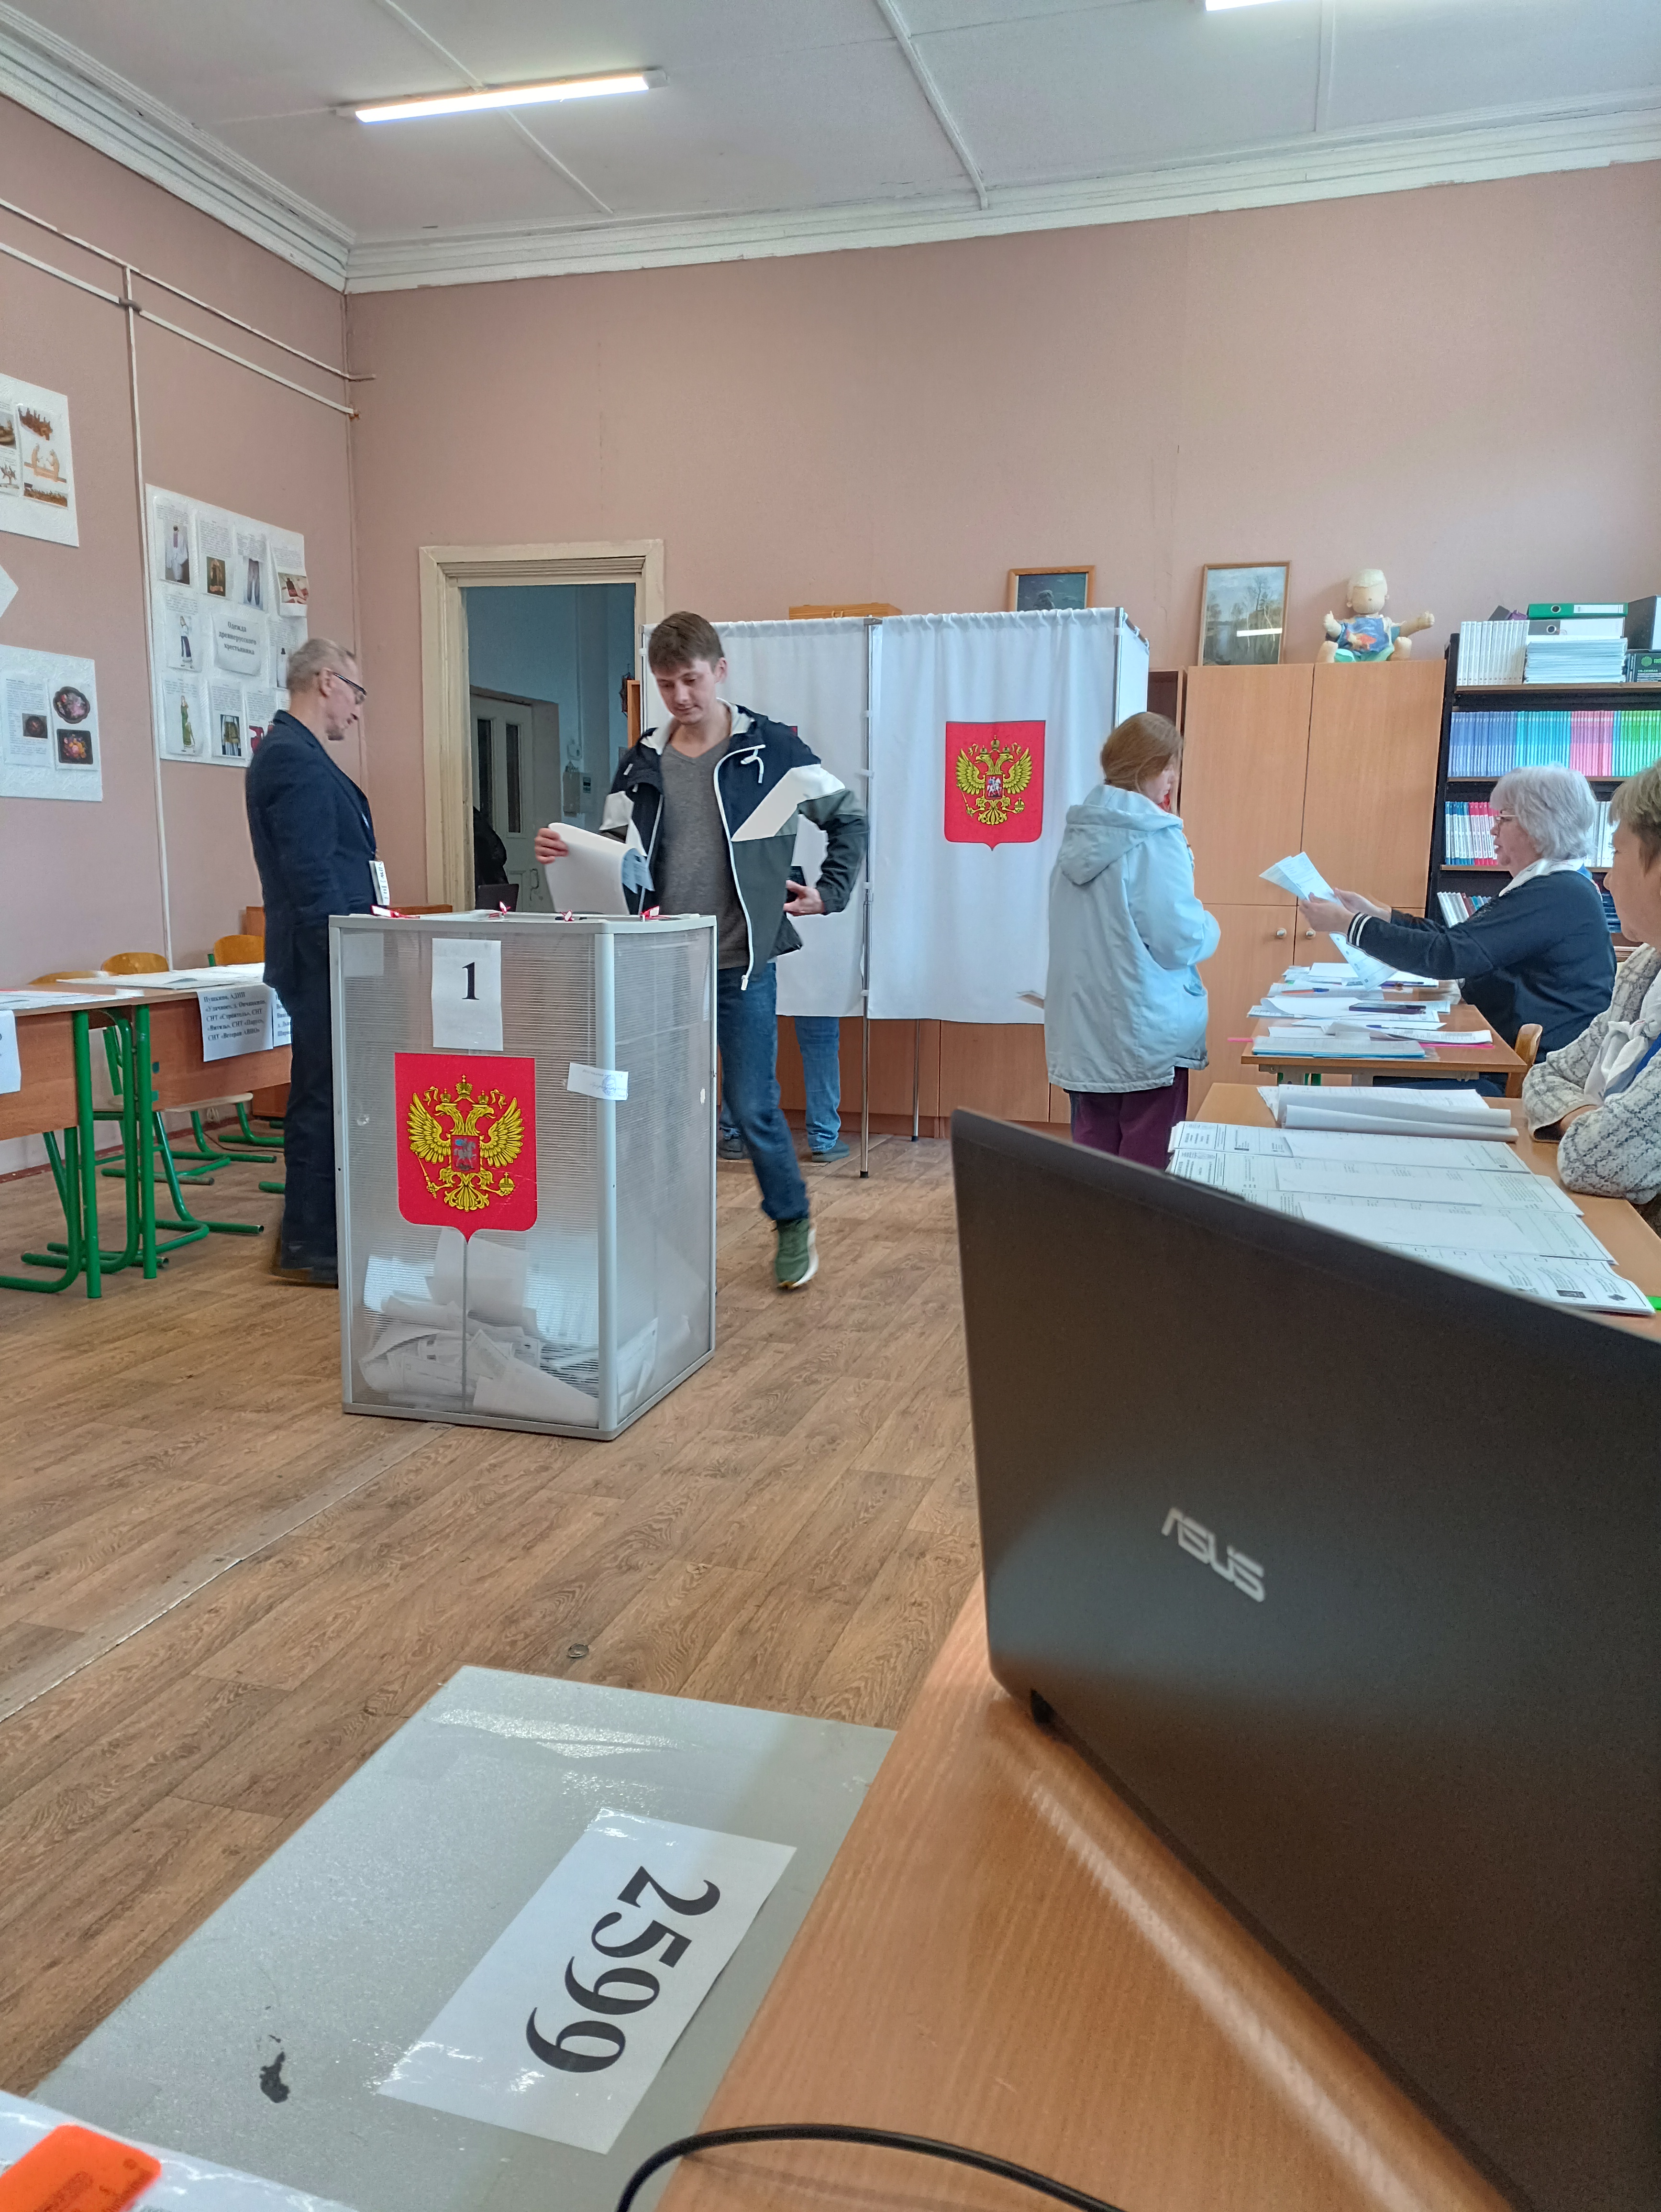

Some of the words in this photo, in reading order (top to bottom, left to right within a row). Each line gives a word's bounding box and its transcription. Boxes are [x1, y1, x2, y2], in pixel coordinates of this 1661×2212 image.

[219, 631, 256, 645] древнерусского
[228, 621, 246, 632] Одежда
[224, 643, 255, 655] крестьянина
[462, 962, 480, 1000] 1
[1161, 1506, 1266, 1603] ASUS
[526, 1865, 720, 2073] 2599
